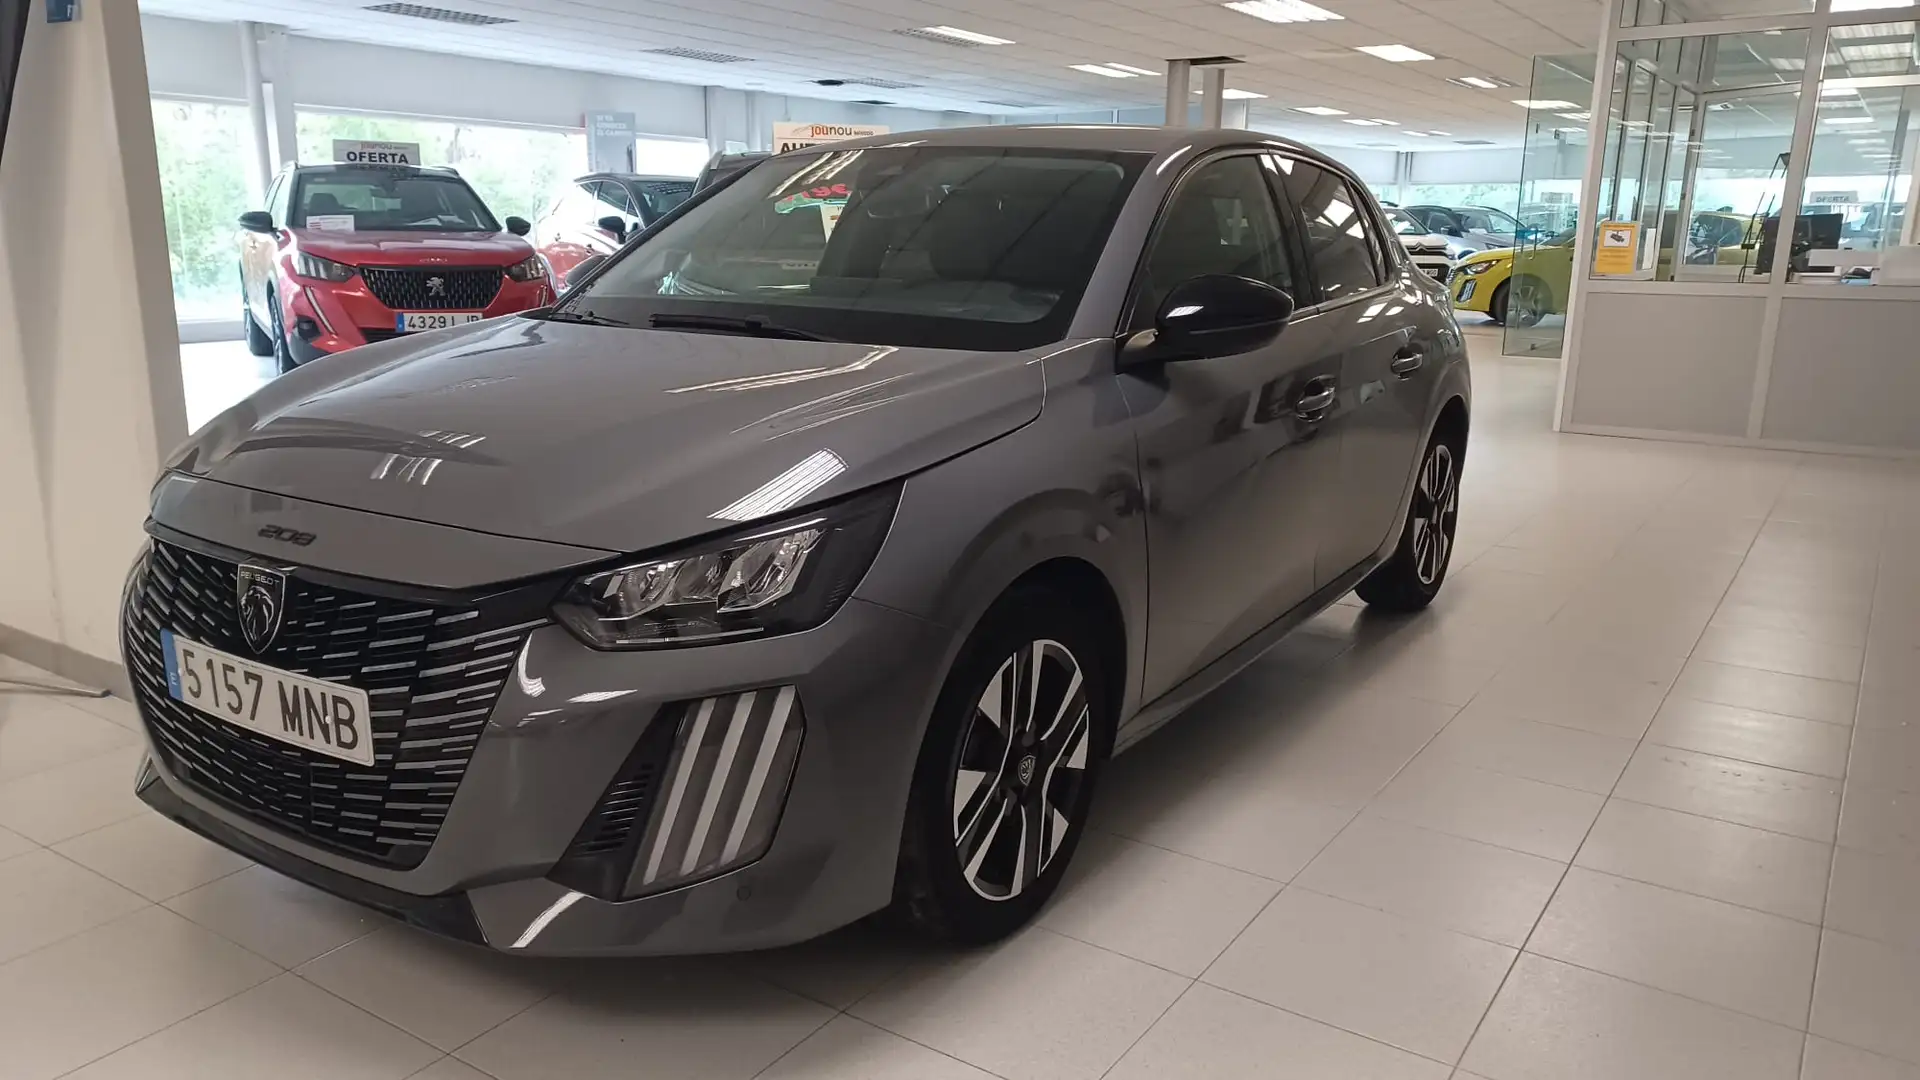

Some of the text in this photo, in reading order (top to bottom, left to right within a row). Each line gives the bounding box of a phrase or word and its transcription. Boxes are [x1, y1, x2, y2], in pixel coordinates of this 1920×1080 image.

[810, 125, 852, 138] jounou
[346, 151, 409, 164] OFERTA
[407, 315, 447, 329] 4329
[257, 524, 317, 547] 208
[240, 572, 281, 586] PEUGEOT
[181, 653, 359, 751] 5157 MNB
